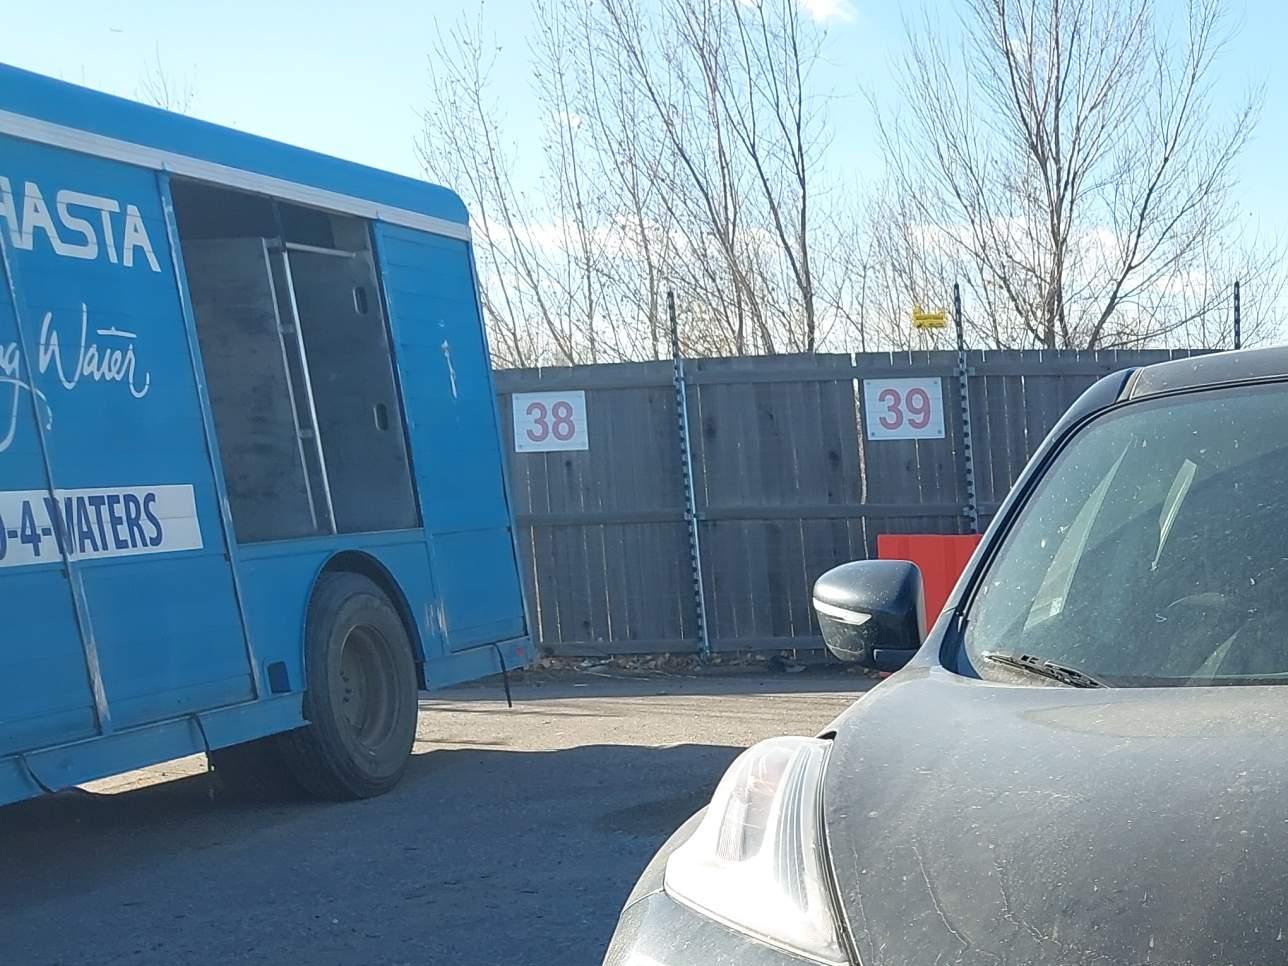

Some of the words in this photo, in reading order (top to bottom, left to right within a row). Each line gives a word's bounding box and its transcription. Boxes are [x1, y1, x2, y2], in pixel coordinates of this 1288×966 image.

[39, 303, 150, 398] Water
[526, 401, 576, 442] 38
[879, 388, 930, 430] 39
